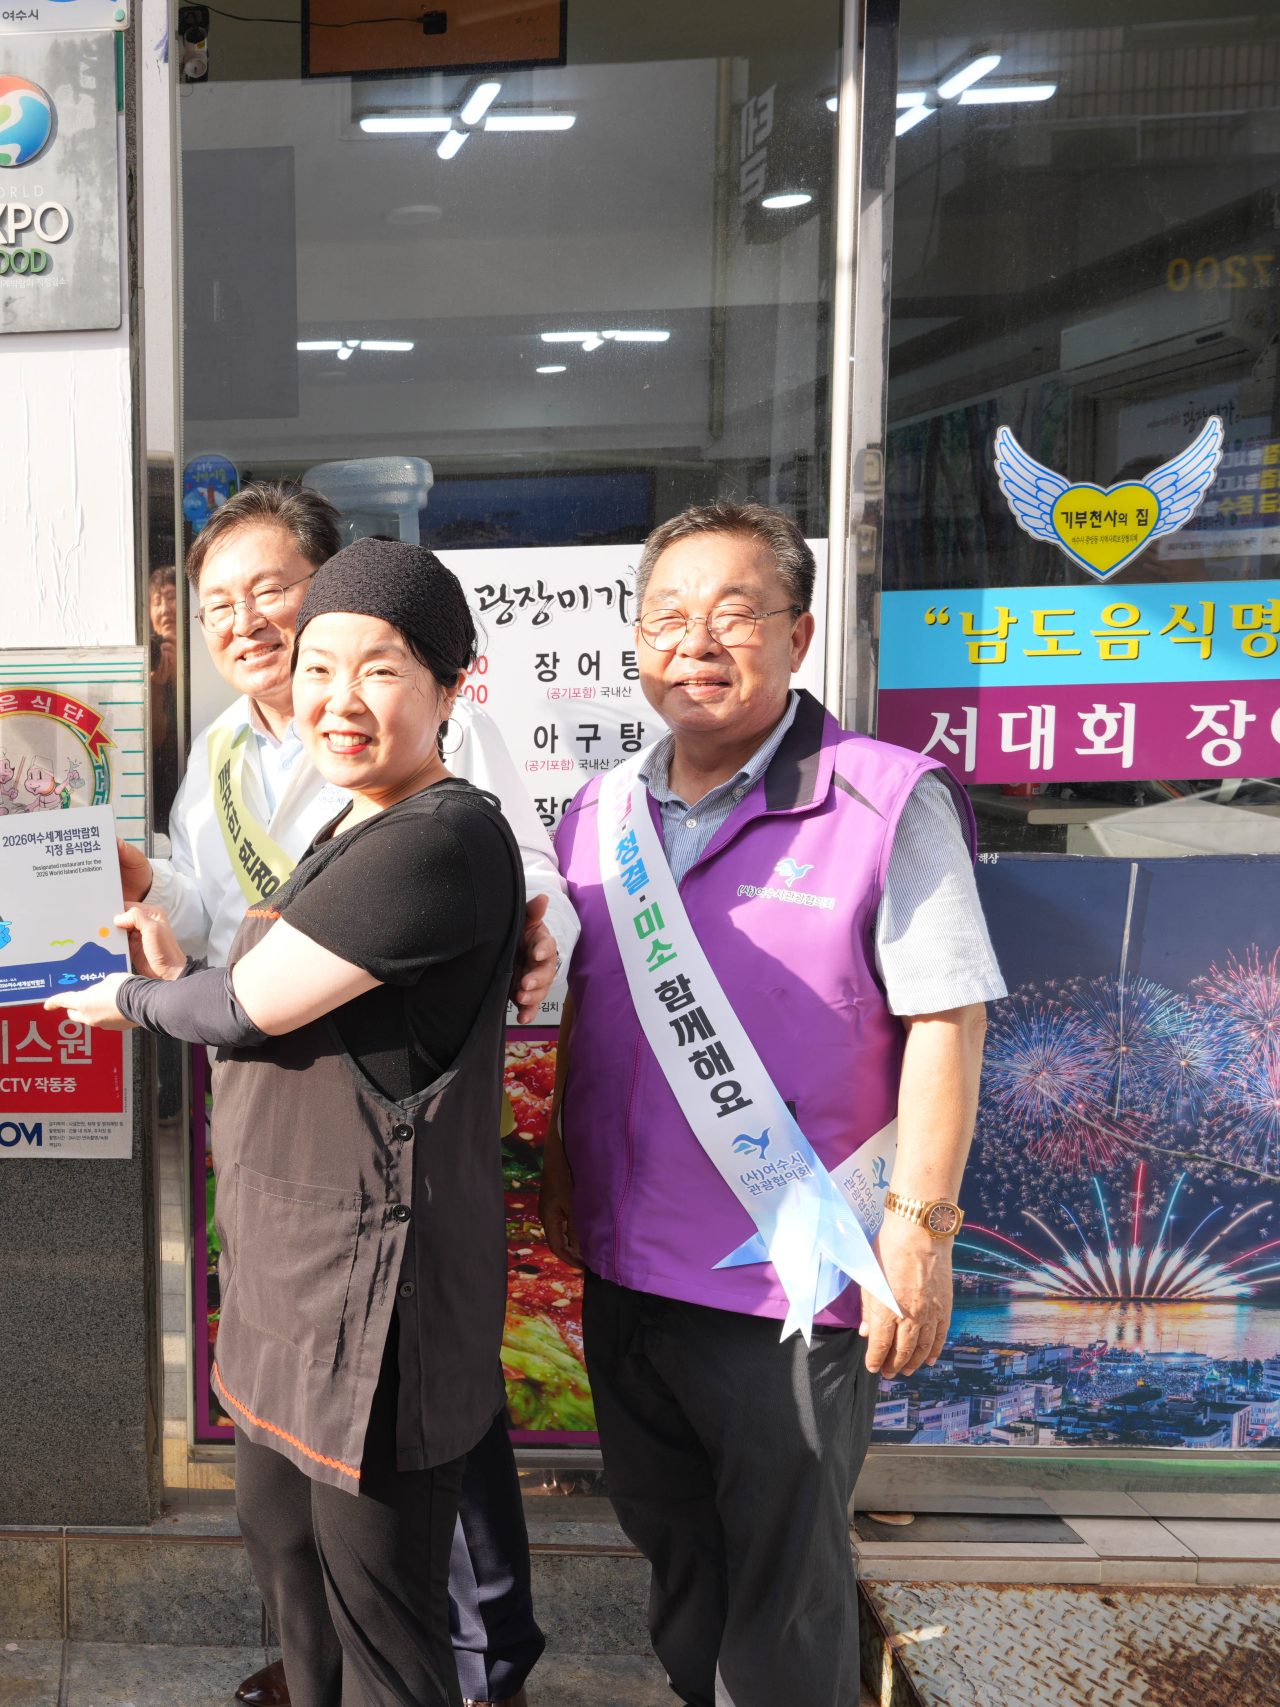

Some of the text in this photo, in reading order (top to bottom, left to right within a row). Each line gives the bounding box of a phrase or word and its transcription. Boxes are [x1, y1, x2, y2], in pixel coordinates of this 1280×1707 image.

[2, 8, 39, 21] 여수시
[1061, 508, 1149, 530] 기부천사의 집
[473, 578, 635, 627] 광장미가
[546, 686, 632, 700] (공기포함) 국내산
[30, 694, 84, 725] 식단
[533, 720, 645, 754] 아구탕
[922, 698, 1280, 773] 서대회 장
[525, 758, 574, 772] (공기포함)
[578, 758, 610, 770] 국내산
[2, 825, 100, 848] 2026여수세계섬박람회
[217, 758, 281, 899] 깨끗한 환경
[45, 841, 102, 857] 지정 음식업소
[632, 901, 679, 972] 미소
[80, 971, 106, 982] 여수시
[539, 1002, 559, 1012] 김치
[654, 973, 754, 1119] 함께해요
[34, 1076, 78, 1093] 작동중
[739, 1151, 807, 1186] (사)여수시
[746, 1164, 814, 1196] 관광협의회
